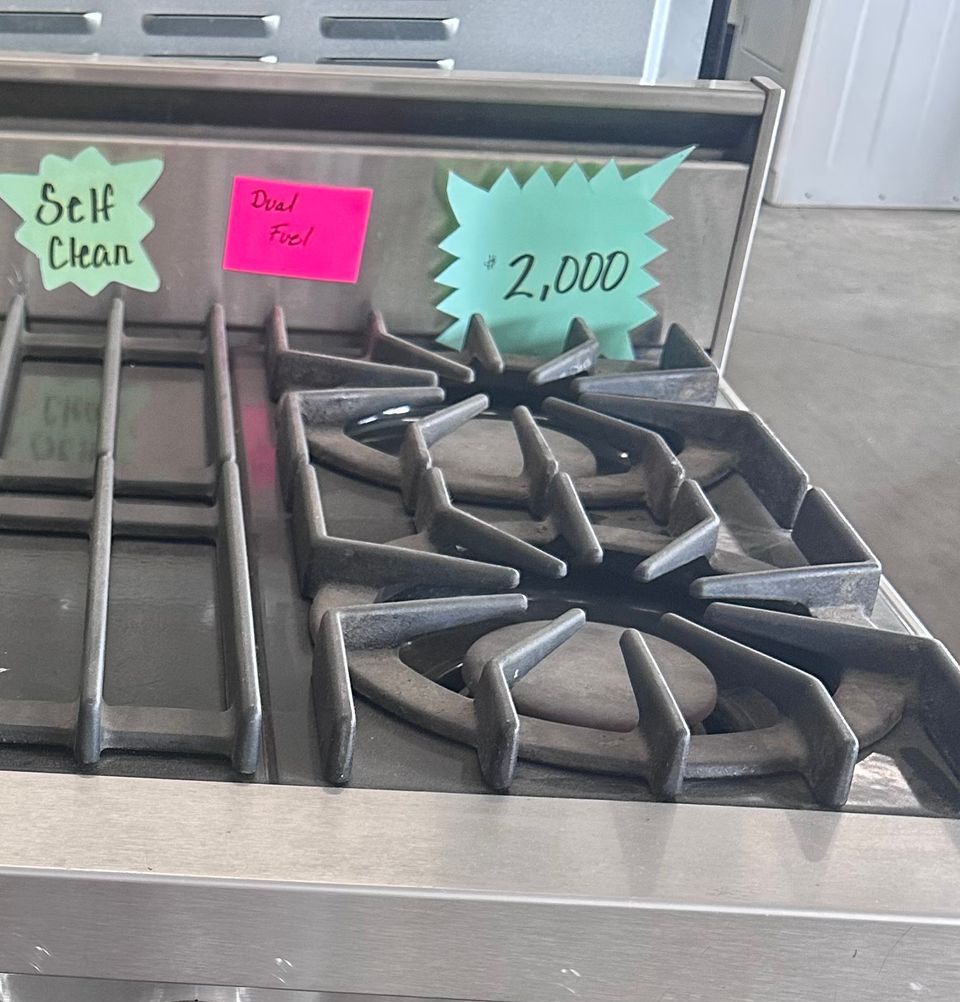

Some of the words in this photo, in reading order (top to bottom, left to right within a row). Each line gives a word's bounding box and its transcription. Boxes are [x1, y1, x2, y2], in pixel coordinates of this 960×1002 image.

[35, 182, 115, 226] Self
[251, 189, 299, 213] Dual
[269, 223, 315, 247] Fuel
[49, 235, 134, 270] Clean
